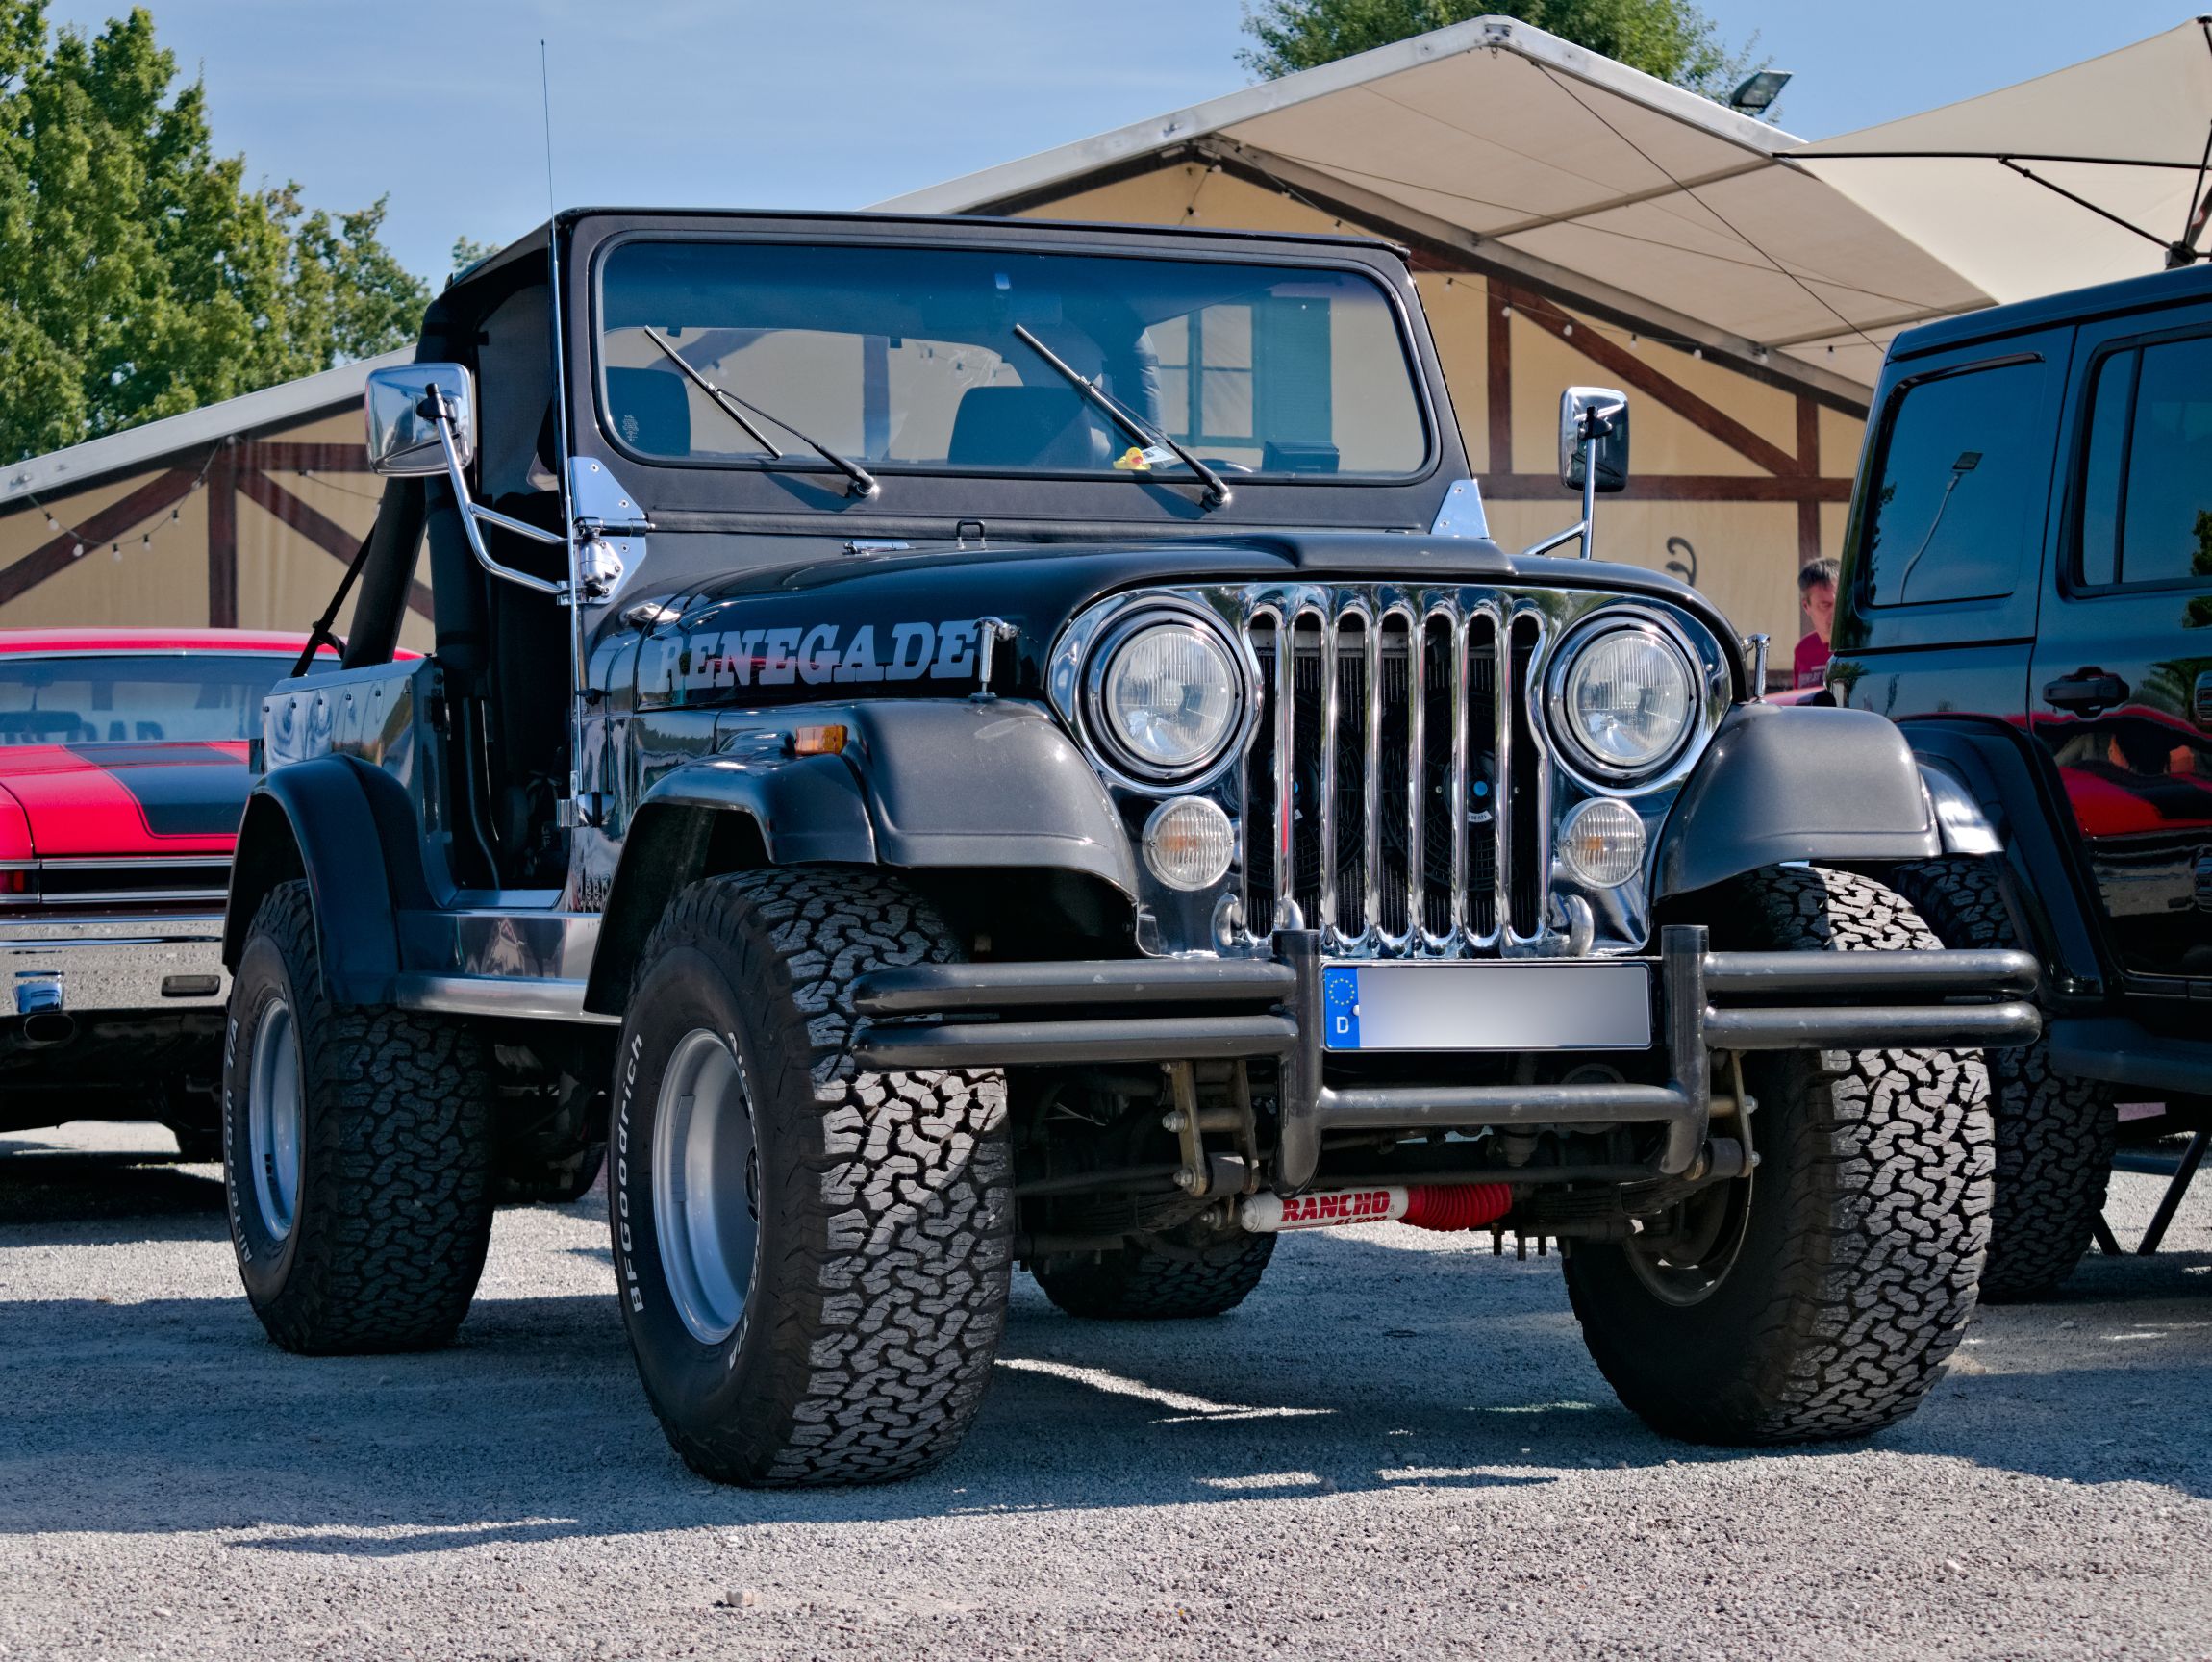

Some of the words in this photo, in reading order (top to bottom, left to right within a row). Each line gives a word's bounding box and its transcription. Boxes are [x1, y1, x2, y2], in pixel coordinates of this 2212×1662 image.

[660, 620, 979, 690] RENEGADE
[1337, 1016, 1349, 1033] D
[618, 1033, 643, 1312] BFGoodrich
[1281, 1192, 1390, 1221] RANCHO
